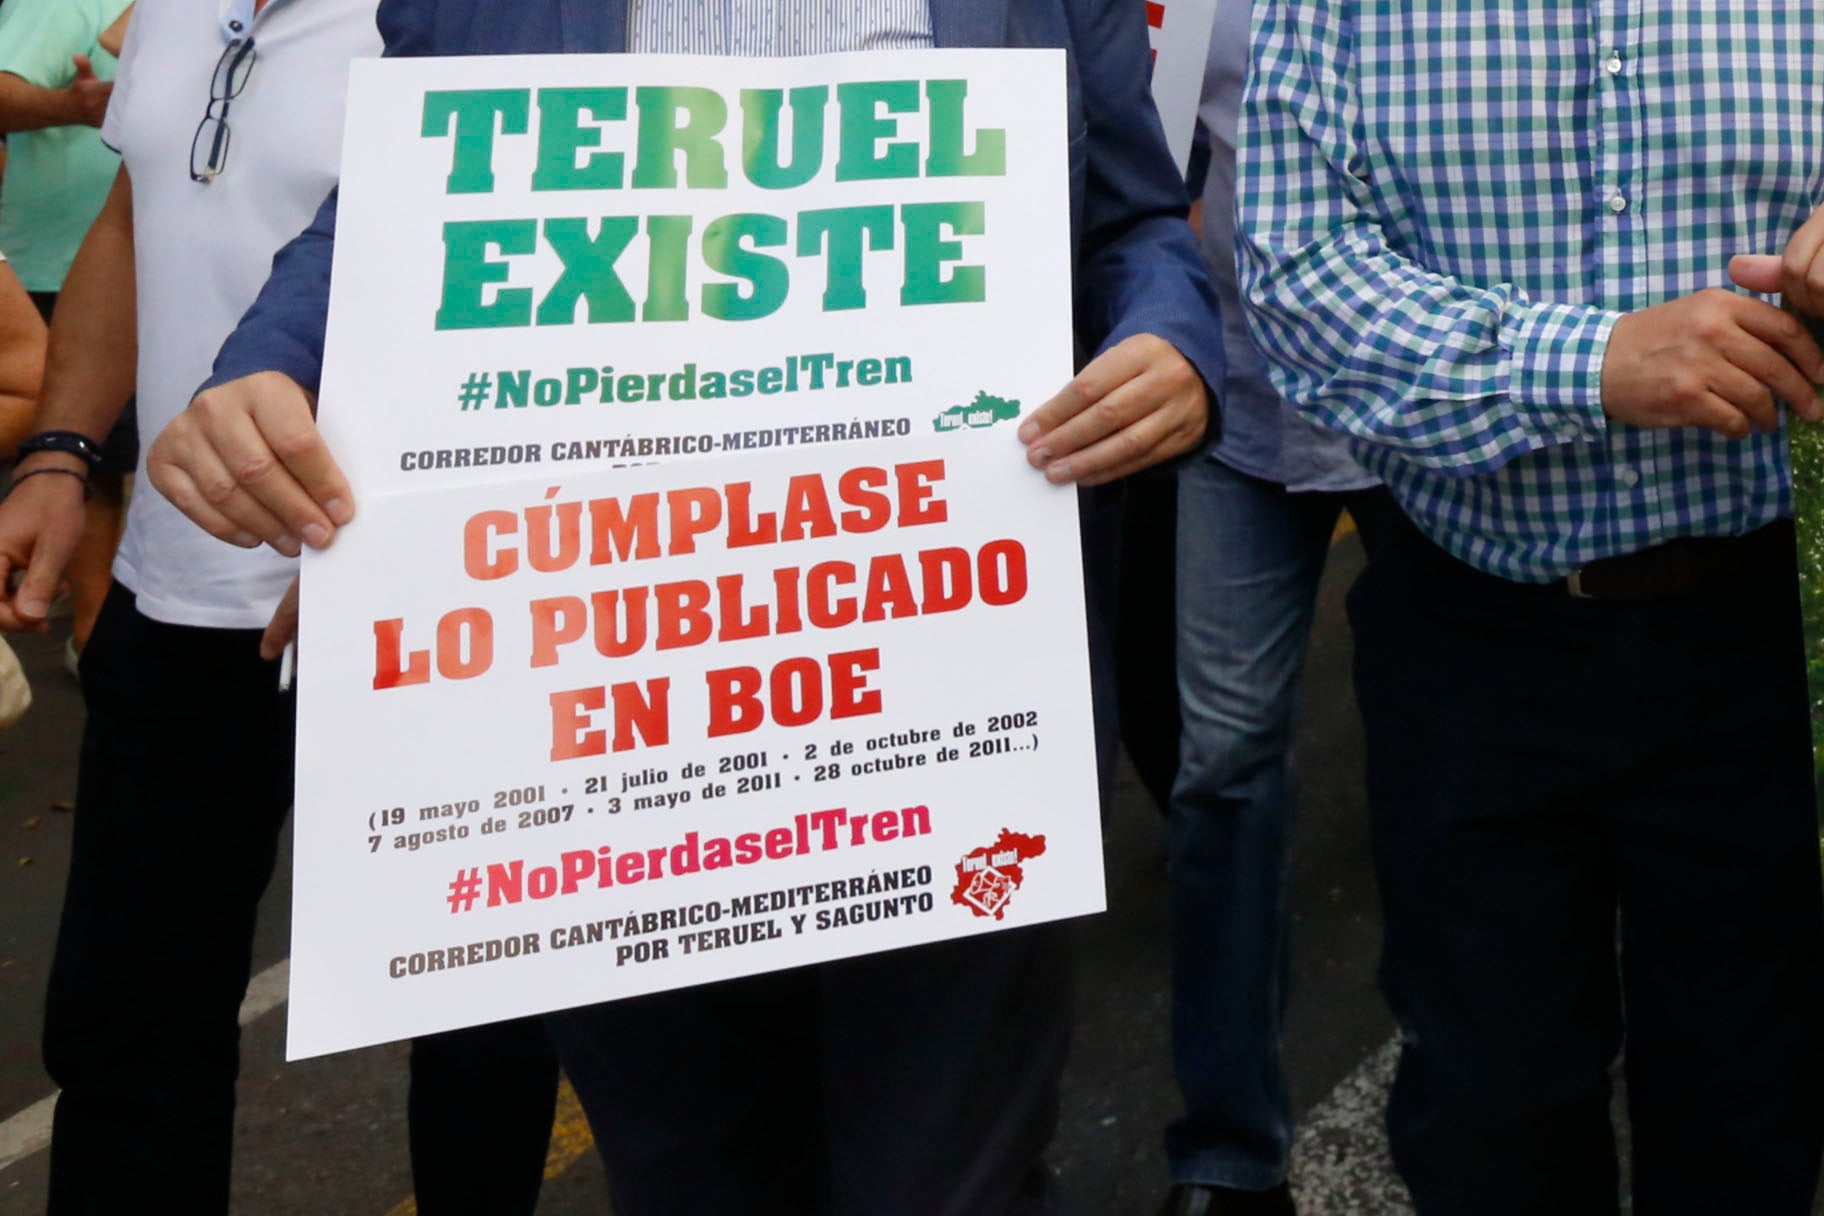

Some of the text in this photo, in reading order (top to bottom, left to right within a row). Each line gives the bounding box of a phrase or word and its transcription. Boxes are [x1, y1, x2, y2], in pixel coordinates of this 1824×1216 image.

[421, 79, 1006, 195] TERUEL
[433, 201, 986, 332] EXISTE
[458, 353, 913, 411] #NoPierdaselTren
[400, 417, 911, 471] CORREDOR CANTÁBRICO-MEDITERRÁNEO
[463, 458, 948, 581] CÚMPLASE
[372, 539, 1029, 691] LO PUBLICADO
[549, 648, 883, 763] EN BOE
[368, 710, 1038, 832] (19 mayo 2001 21 julio de 2001 2 de octubre de 2002
[368, 835, 383, 853] 7
[394, 825, 469, 852] agosto
[481, 817, 507, 835] de
[518, 804, 575, 830] 2007
[608, 797, 622, 815] 3
[634, 790, 691, 812] mayo
[701, 782, 726, 800] de
[737, 772, 781, 795] 2011
[814, 763, 841, 782] 28
[851, 751, 926, 777] octubre
[936, 746, 959, 764] de
[446, 805, 931, 914] #NoPierdaselTren
[389, 864, 932, 979] CORREDOR CANTÁBRICO-MEDITERRÁNEO
[615, 892, 934, 967] POR TERUEL Y SAGUNTO
